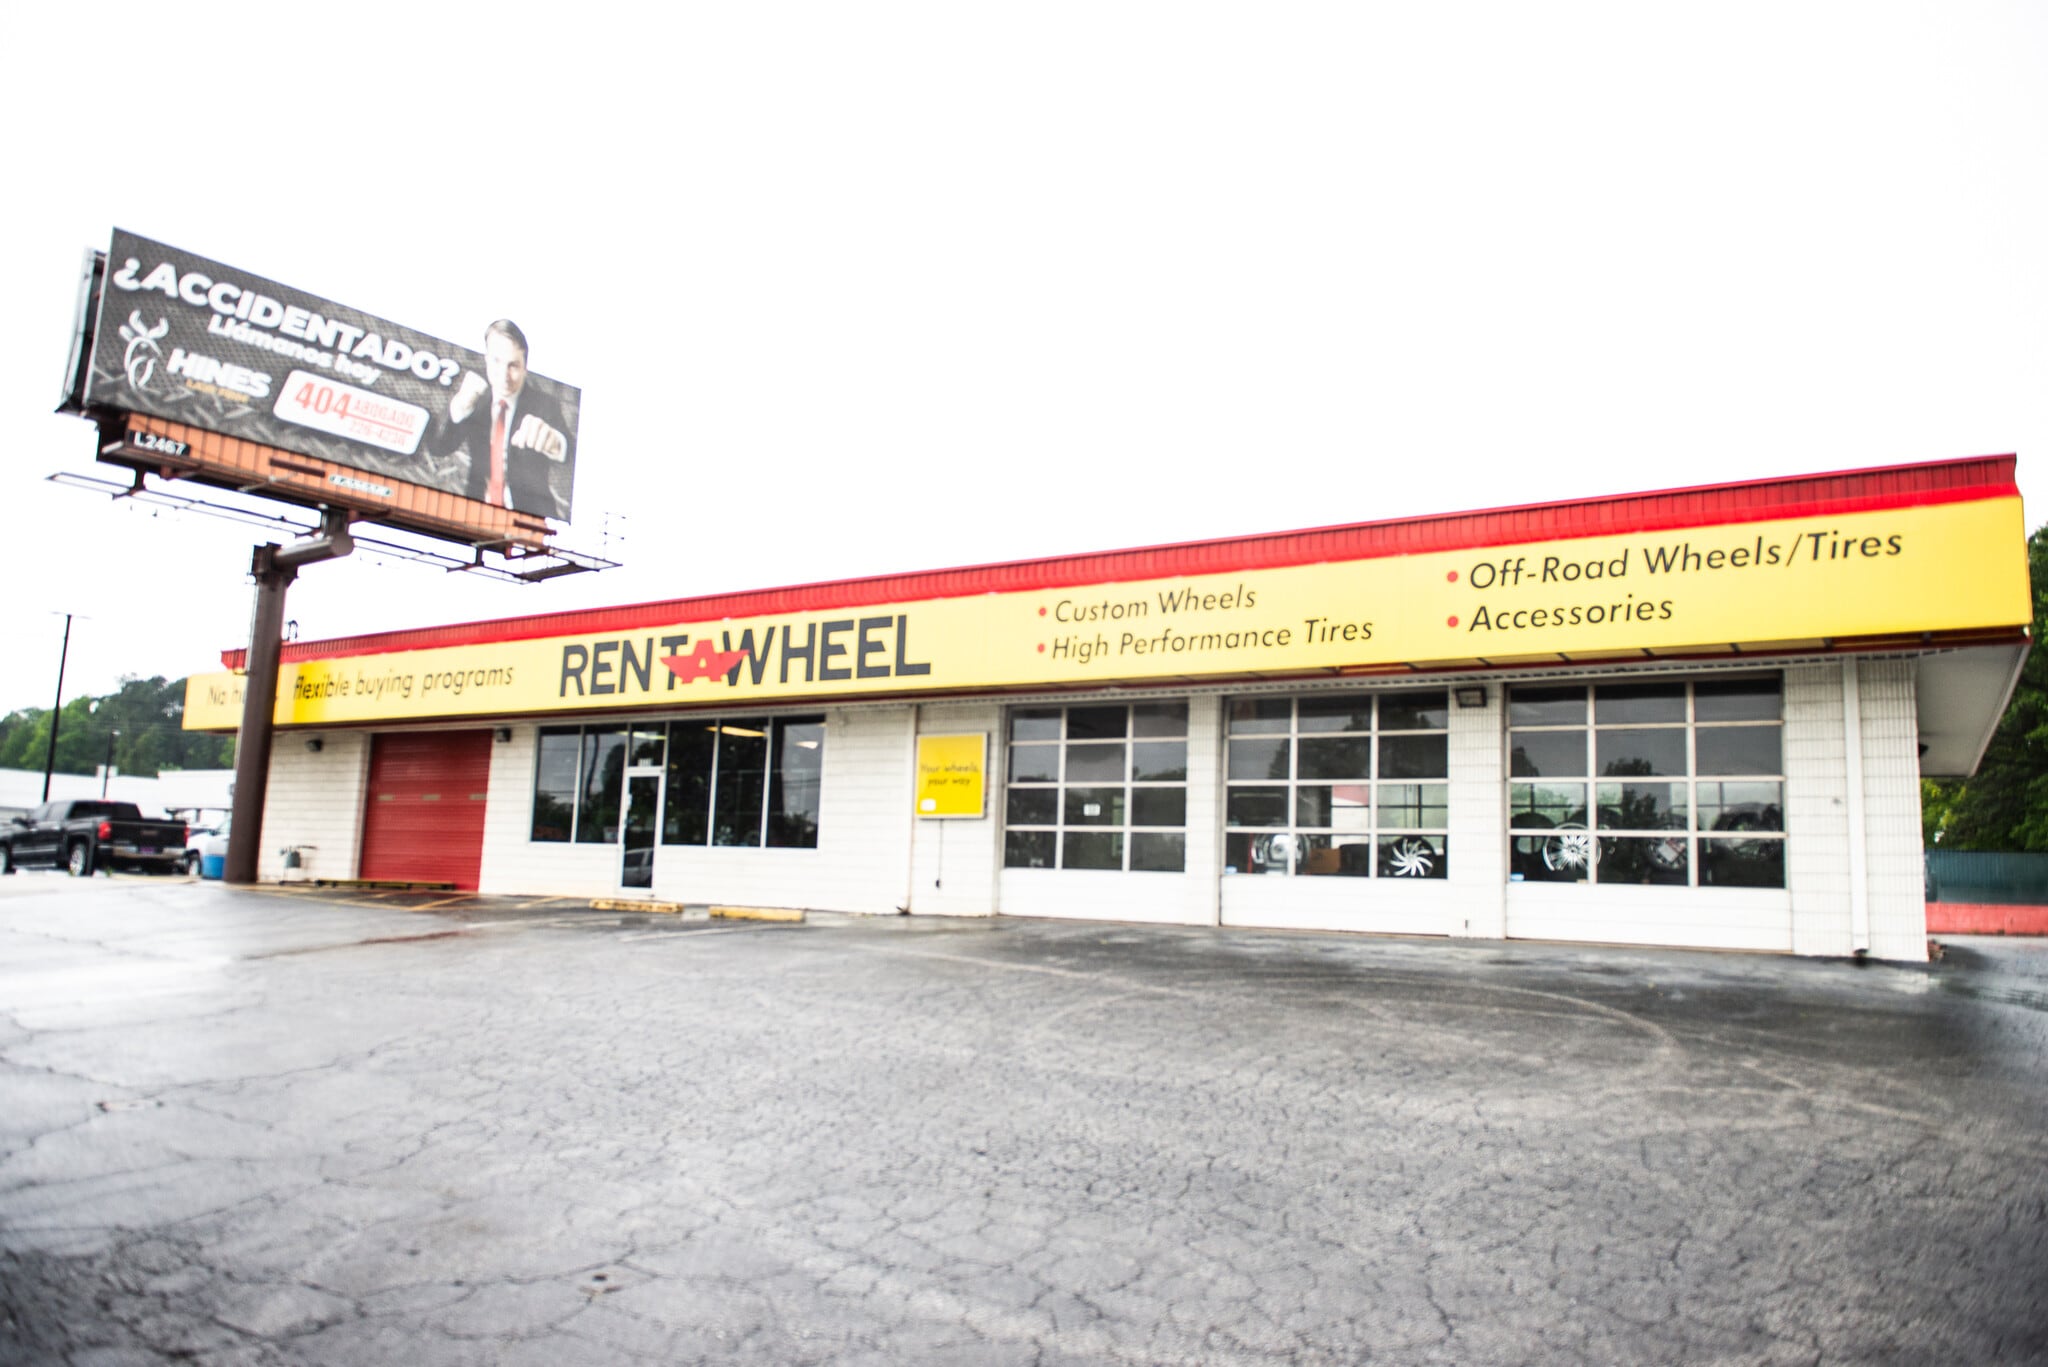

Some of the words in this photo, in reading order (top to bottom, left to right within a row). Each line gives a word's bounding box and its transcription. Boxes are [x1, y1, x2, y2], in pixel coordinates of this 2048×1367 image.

[113, 257, 461, 387] ¿ACCIDENTADO?
[166, 347, 272, 398] HINES
[334, 353, 382, 385] hoy
[294, 382, 352, 419] 404
[354, 399, 416, 428] ABOGADO
[1469, 548, 1629, 589] Off-Road
[1643, 529, 1905, 575] Wheels/Tires
[1055, 600, 1148, 623] Custom
[1158, 584, 1256, 614] Wheels
[1469, 593, 1674, 633] Accessories
[560, 635, 688, 697] RENT
[722, 614, 932, 687] WHEEL
[1052, 634, 1109, 664] High
[1120, 628, 1291, 655] Performance
[1304, 618, 1373, 643] Tires
[293, 673, 350, 701] flexible
[355, 668, 413, 700] buying
[421, 665, 514, 699] programs
